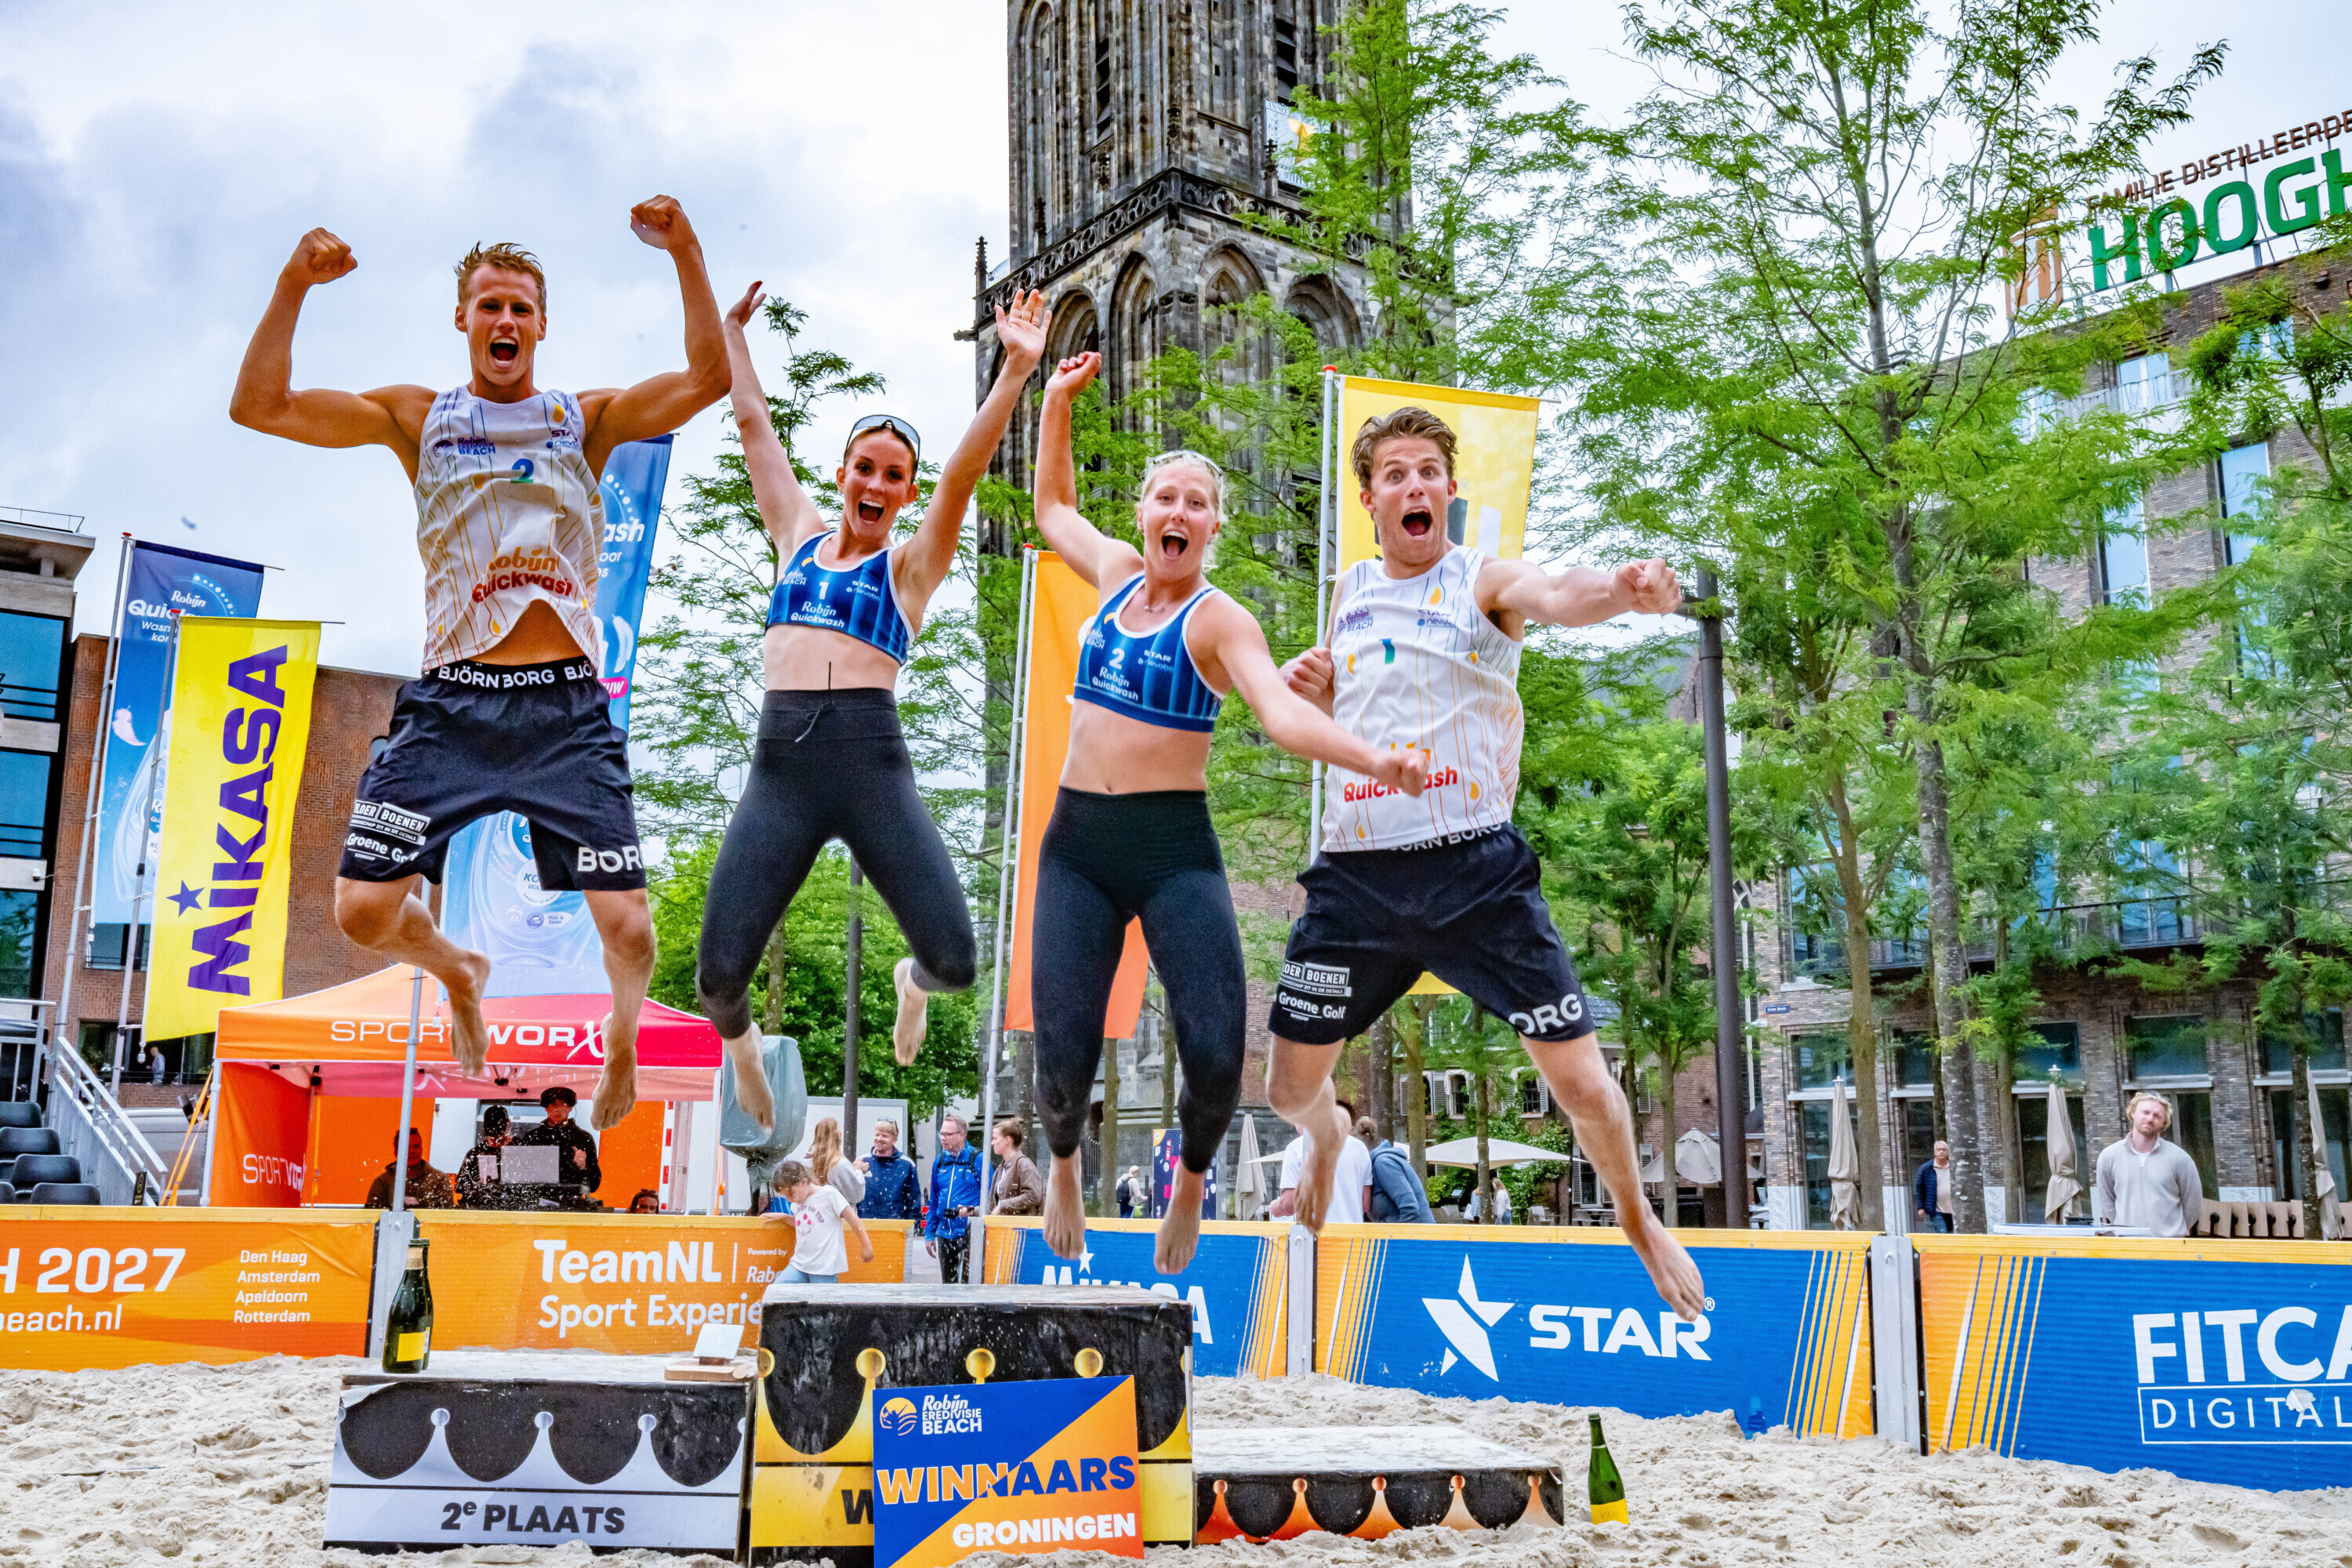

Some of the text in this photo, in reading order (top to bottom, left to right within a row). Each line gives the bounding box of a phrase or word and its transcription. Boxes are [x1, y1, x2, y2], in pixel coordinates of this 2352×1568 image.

[459, 446, 496, 456] BEACH
[510, 458, 535, 484] 2
[818, 581, 830, 601] 1
[851, 580, 879, 593] STAR
[170, 590, 206, 608] Robijn
[801, 601, 837, 617] Robijn
[790, 612, 845, 628] Quickwash
[1347, 622, 1374, 633] BEACH
[1109, 648, 1125, 670] 2
[1144, 649, 1171, 662] STAR
[438, 661, 593, 688] BJÖRN BORG BJÖ
[1099, 666, 1130, 688] Robijn
[1092, 677, 1139, 702] Quickwash
[380, 809, 425, 833] BOENEN
[347, 833, 388, 855] Groene
[398, 831, 417, 841] DETAILS
[577, 845, 645, 873] BOR
[1306, 969, 1346, 985] BOENEN
[1279, 992, 1347, 1018] Groene Golf
[1508, 993, 1583, 1035] ORG
[816, 1210, 825, 1224] TOP
[240, 1250, 307, 1266] Den Haag
[533, 1240, 722, 1283] TeamNL
[778, 1247, 786, 1257] by
[36, 1247, 186, 1293] 2027
[238, 1269, 320, 1283] Amsterdam
[235, 1289, 307, 1306] Apeldoorn
[234, 1309, 310, 1323] Rotterdam
[538, 1294, 637, 1338] Sport
[1530, 1305, 1712, 1361] STAR
[923, 1394, 968, 1411] Robijn
[922, 1408, 982, 1421] EREDIVISIE
[922, 1417, 982, 1436] BEACH
[876, 1455, 1136, 1505] WINNAARS
[482, 1504, 626, 1535] PLAATS
[952, 1512, 1136, 1548] GRONINGEN
